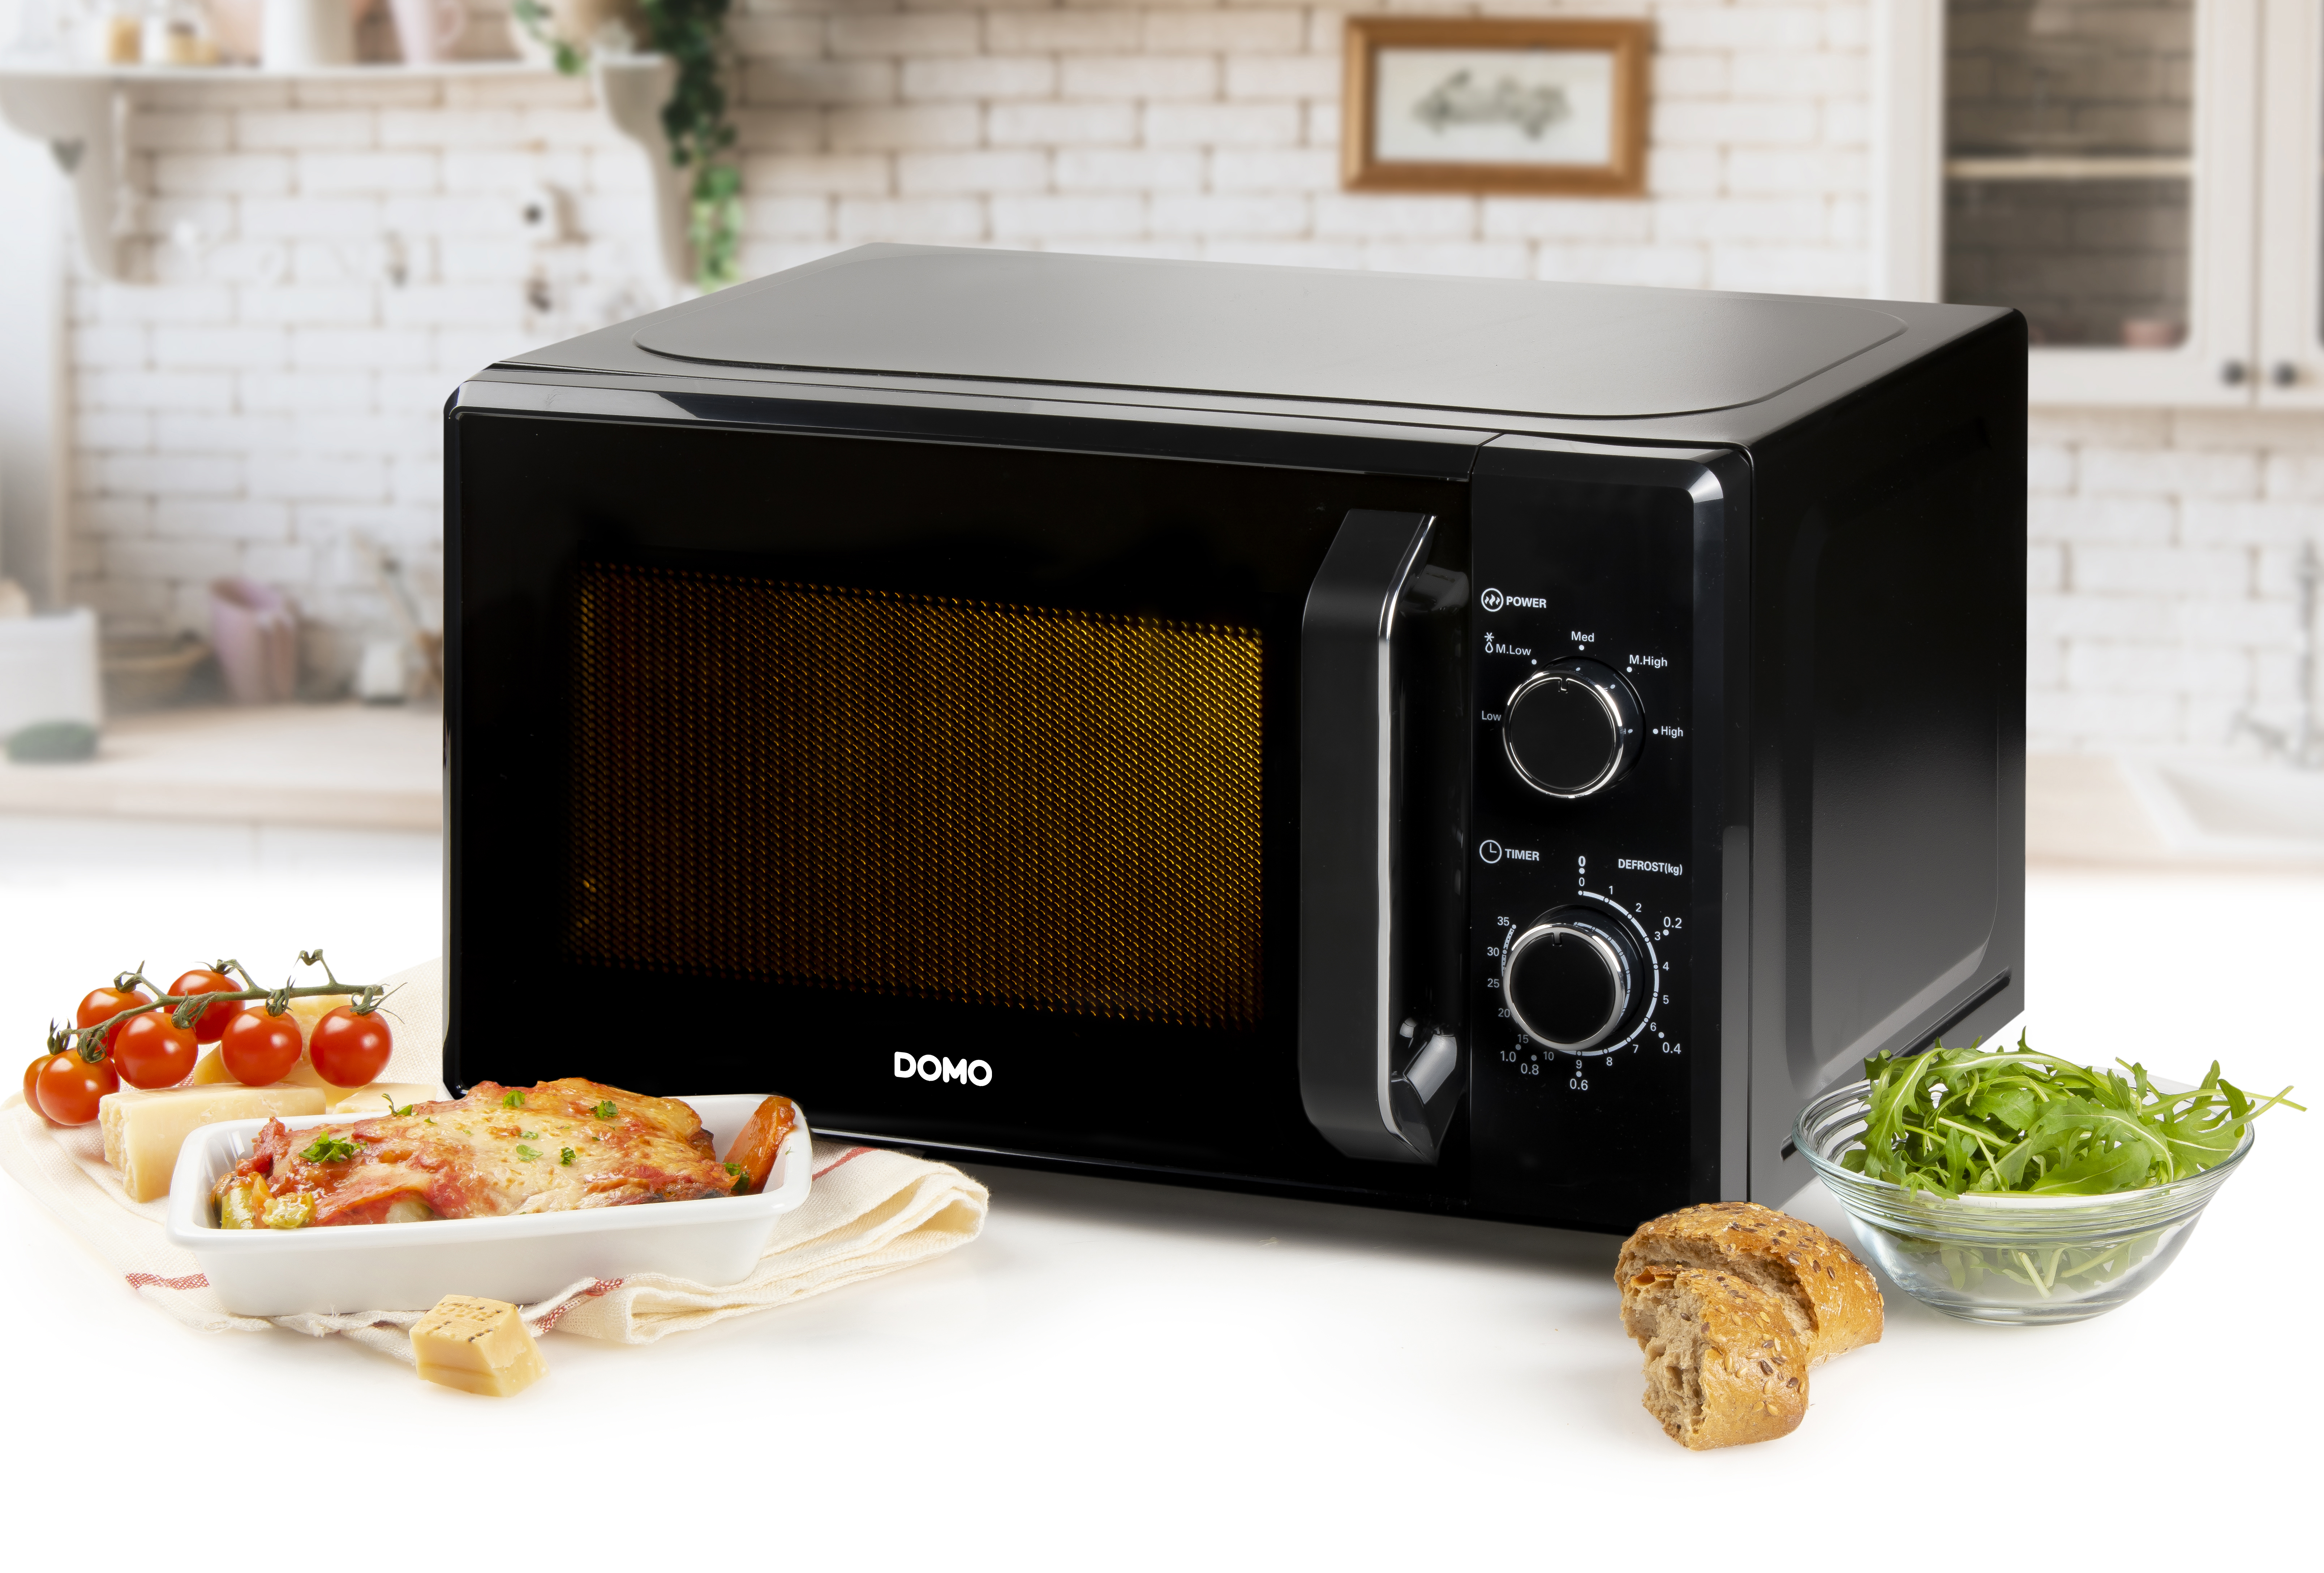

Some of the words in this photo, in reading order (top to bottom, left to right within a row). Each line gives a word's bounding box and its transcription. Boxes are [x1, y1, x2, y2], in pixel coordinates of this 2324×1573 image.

[1506, 596, 1546, 608] POWER
[1571, 631, 1594, 642] Med
[1496, 644, 1531, 655] M.Low
[1629, 655, 1667, 668] M.High
[1482, 710, 1502, 721] Low
[1661, 725, 1683, 738] High
[1504, 849, 1539, 861] TIMER
[1578, 856, 1586, 867] 0
[1618, 859, 1683, 876] DEFROST(kg)
[1578, 877, 1585, 887] 0
[1609, 885, 1613, 895] 1
[1636, 903, 1642, 912] 2
[1497, 916, 1509, 926] 35
[1663, 916, 1682, 928] 0.2
[1654, 931, 1661, 940] 3
[1487, 947, 1499, 956] 30
[1662, 961, 1670, 971] 4
[1487, 978, 1500, 988] 25
[1663, 995, 1669, 1004] 5
[1499, 1009, 1510, 1018] 20
[1650, 1022, 1656, 1031] 6
[1518, 1034, 1529, 1043] 15
[1632, 1044, 1639, 1053] 7
[1662, 1042, 1681, 1054] 0.4
[1500, 1051, 1516, 1062] 1.0
[1543, 1051, 1554, 1061] 10
[1576, 1060, 1582, 1069] 9
[1606, 1057, 1612, 1066] 8
[894, 1051, 992, 1087] DOMO
[1521, 1063, 1539, 1075] 0.8
[1570, 1078, 1588, 1091] 0.6
